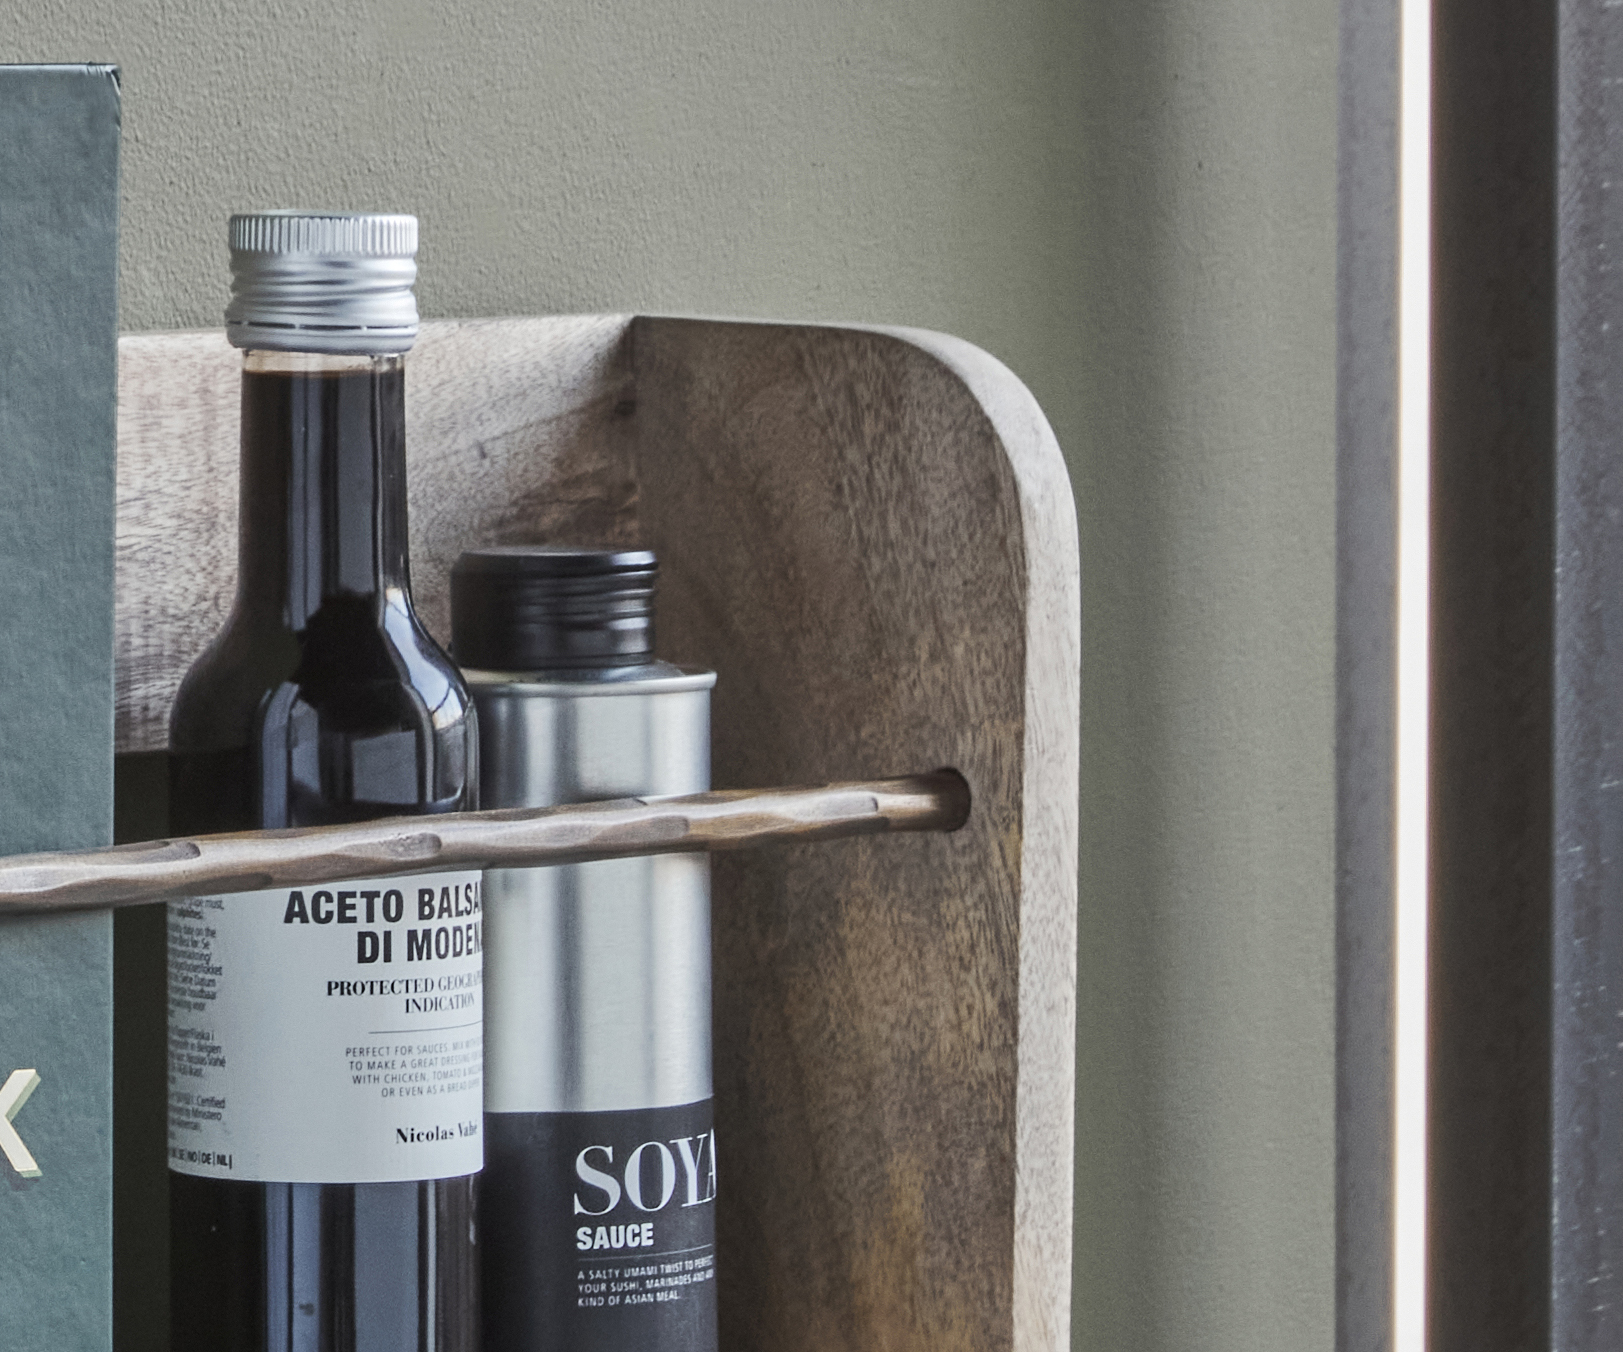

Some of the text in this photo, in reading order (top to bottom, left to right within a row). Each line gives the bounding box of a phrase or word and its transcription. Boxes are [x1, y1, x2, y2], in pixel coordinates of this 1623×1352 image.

[283, 888, 404, 925] ACETO
[357, 930, 392, 964] DI
[327, 977, 434, 997] PROTECTED
[404, 992, 475, 1014] INDICATION
[345, 1046, 390, 1058] PERFECT
[395, 1045, 413, 1056] FOR
[349, 1060, 363, 1071] TO
[367, 1059, 396, 1071] MAKE
[400, 1058, 407, 1069] A
[411, 1056, 438, 1069] GREAT
[352, 1074, 380, 1085] WITH
[381, 1087, 395, 1098] OR
[399, 1086, 423, 1098] EVEN
[427, 1084, 437, 1096] AS
[439, 1083, 446, 1094] A
[396, 1125, 454, 1145] Nicolas
[573, 1127, 716, 1216] SOYA
[576, 1222, 654, 1251] SAUCE
[577, 1270, 585, 1280] A
[588, 1268, 620, 1281] SALTY
[623, 1265, 658, 1279] UMAMI
[578, 1282, 607, 1295] YOUR
[578, 1297, 605, 1307] KIND
[608, 1295, 621, 1306] OF
[624, 1292, 655, 1305] ASIAN
